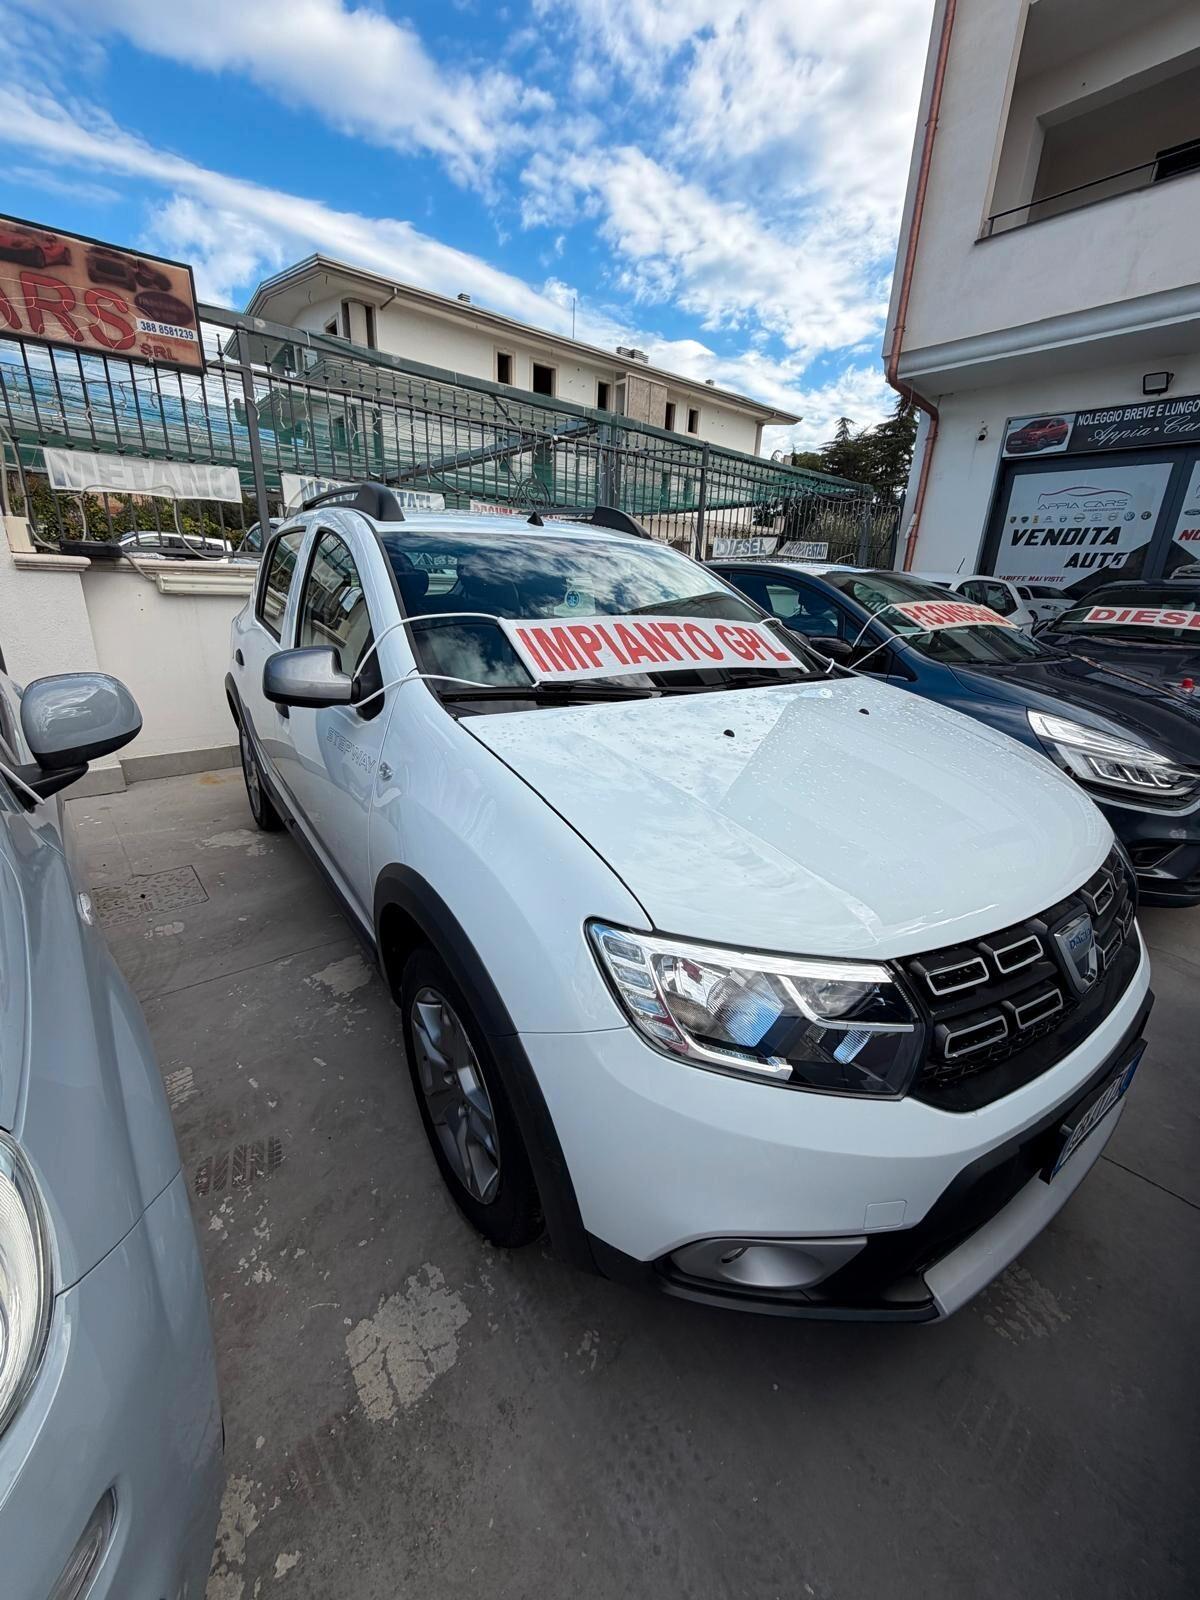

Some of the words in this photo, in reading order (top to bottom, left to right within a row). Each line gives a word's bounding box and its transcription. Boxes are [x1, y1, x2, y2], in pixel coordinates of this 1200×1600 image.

[140, 321, 157, 333] 388
[159, 325, 194, 340] 8581239
[1077, 410, 1123, 427] NOLEGGIO
[1123, 405, 1156, 421] BREVE
[1156, 404, 1165, 417] E
[1165, 399, 1200, 416] LUNGO
[1087, 424, 1152, 446] Appia
[47, 449, 239, 501] METANO
[1038, 502, 1080, 511] APPIA
[1083, 499, 1128, 508] CARS
[1010, 526, 1122, 546] VENDITA
[716, 537, 767, 556] DIESEL
[1063, 552, 1130, 569] AUTO
[515, 622, 725, 673] IMPIANTO
[715, 624, 793, 662] GPL
